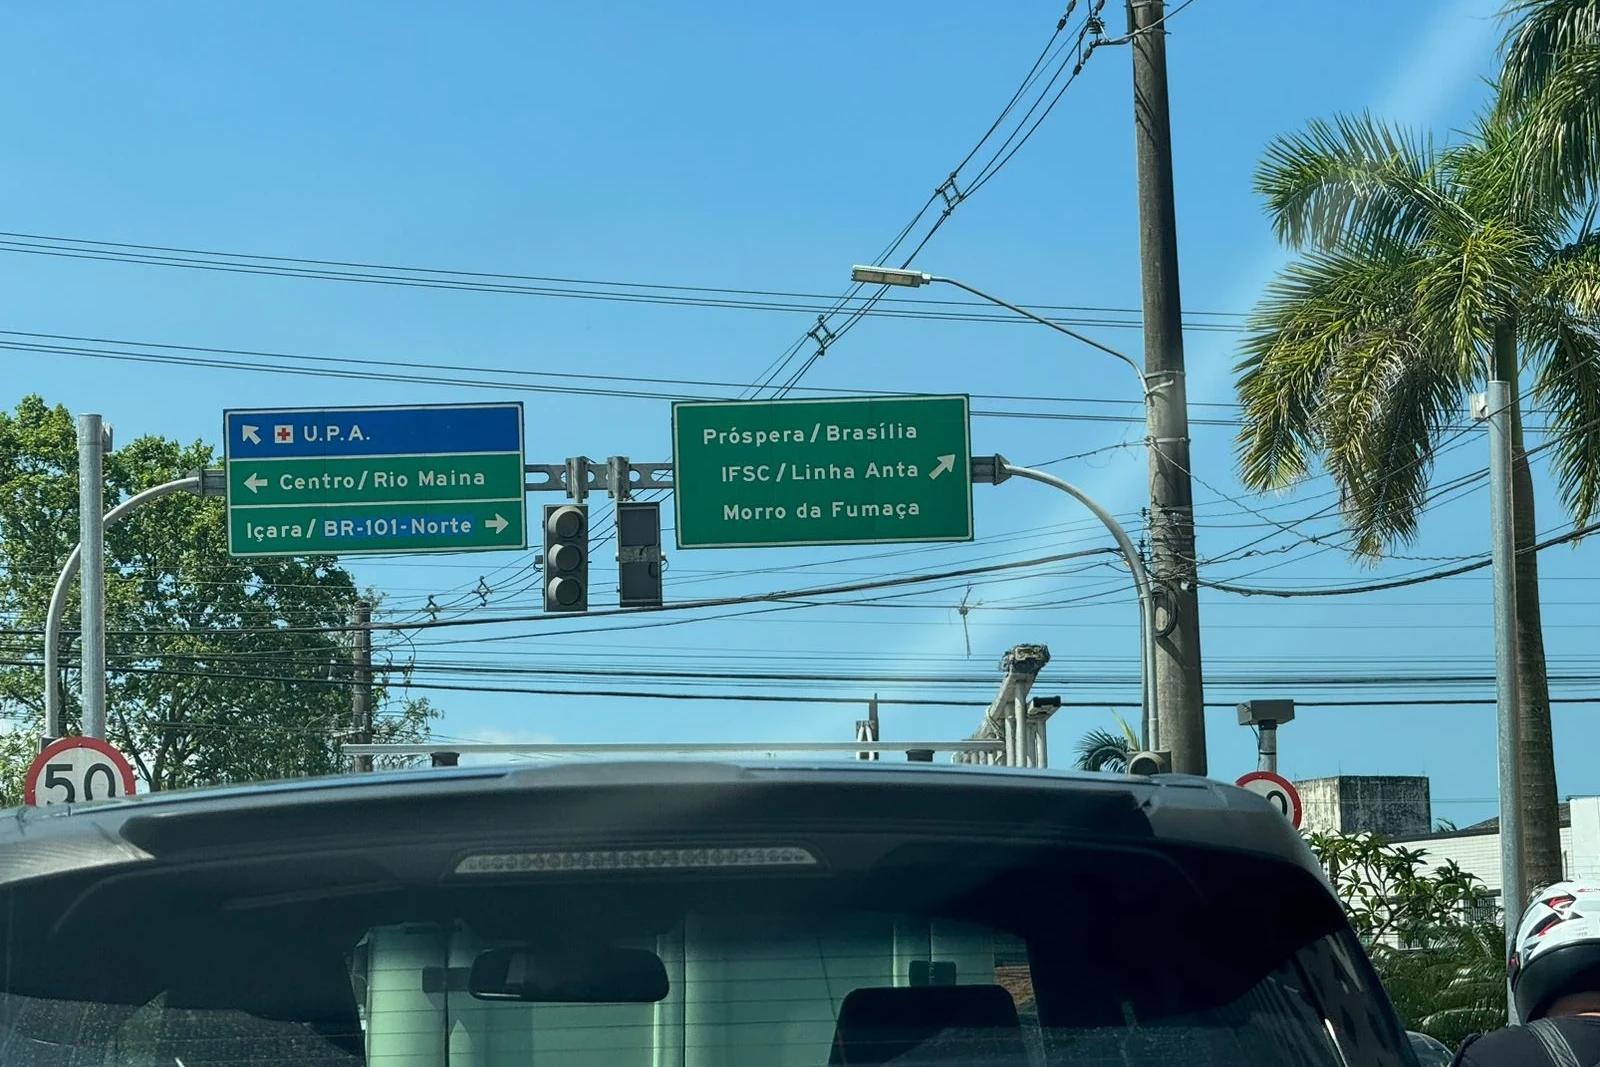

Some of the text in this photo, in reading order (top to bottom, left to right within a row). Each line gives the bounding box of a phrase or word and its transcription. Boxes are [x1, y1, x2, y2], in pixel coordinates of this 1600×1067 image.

[303, 424, 370, 443] U.P.A.
[418, 469, 486, 487] Maina
[865, 462, 919, 480] Anta
[723, 501, 919, 522] Morro da Fumaça
[45, 763, 116, 804] 50
